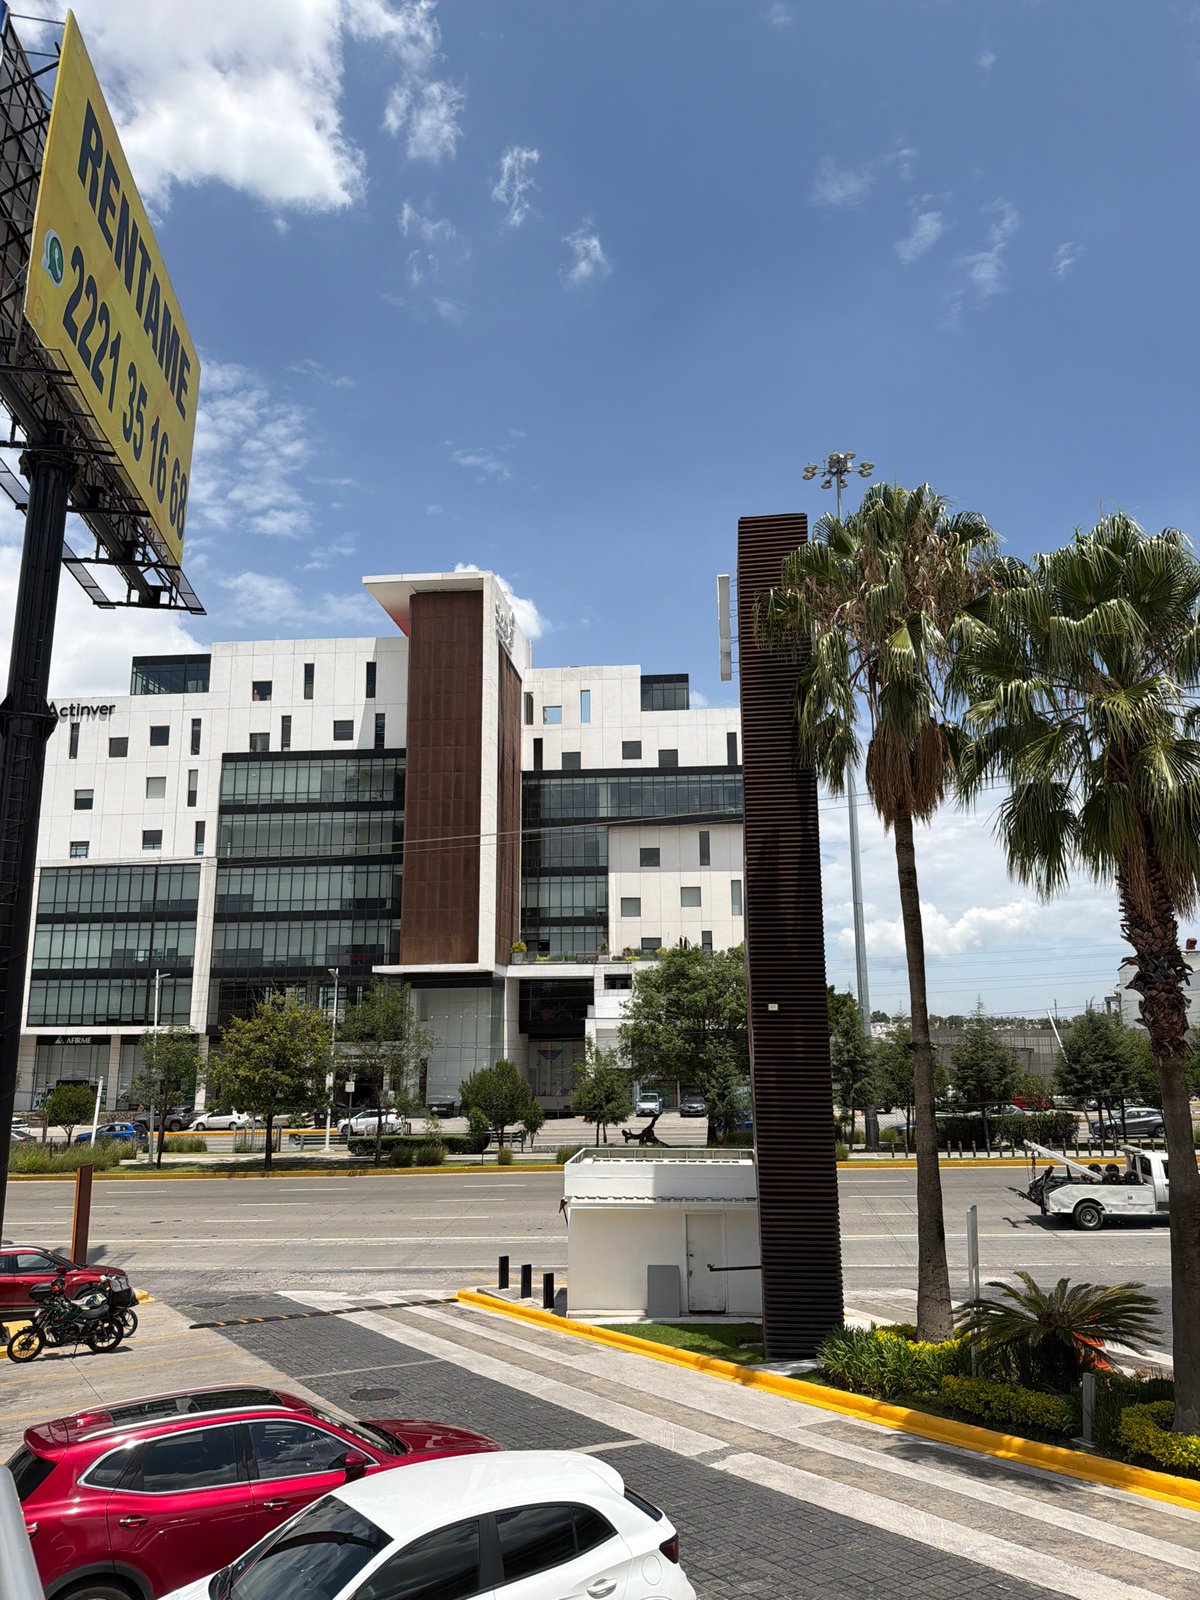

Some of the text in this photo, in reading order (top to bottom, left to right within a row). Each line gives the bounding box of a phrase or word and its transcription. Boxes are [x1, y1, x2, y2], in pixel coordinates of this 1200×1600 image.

[77, 98, 190, 421] RENTAME
[63, 245, 187, 541] 2221 35 16 68
[48, 701, 116, 718] Actinver
[66, 1036, 93, 1045] AFIRME
